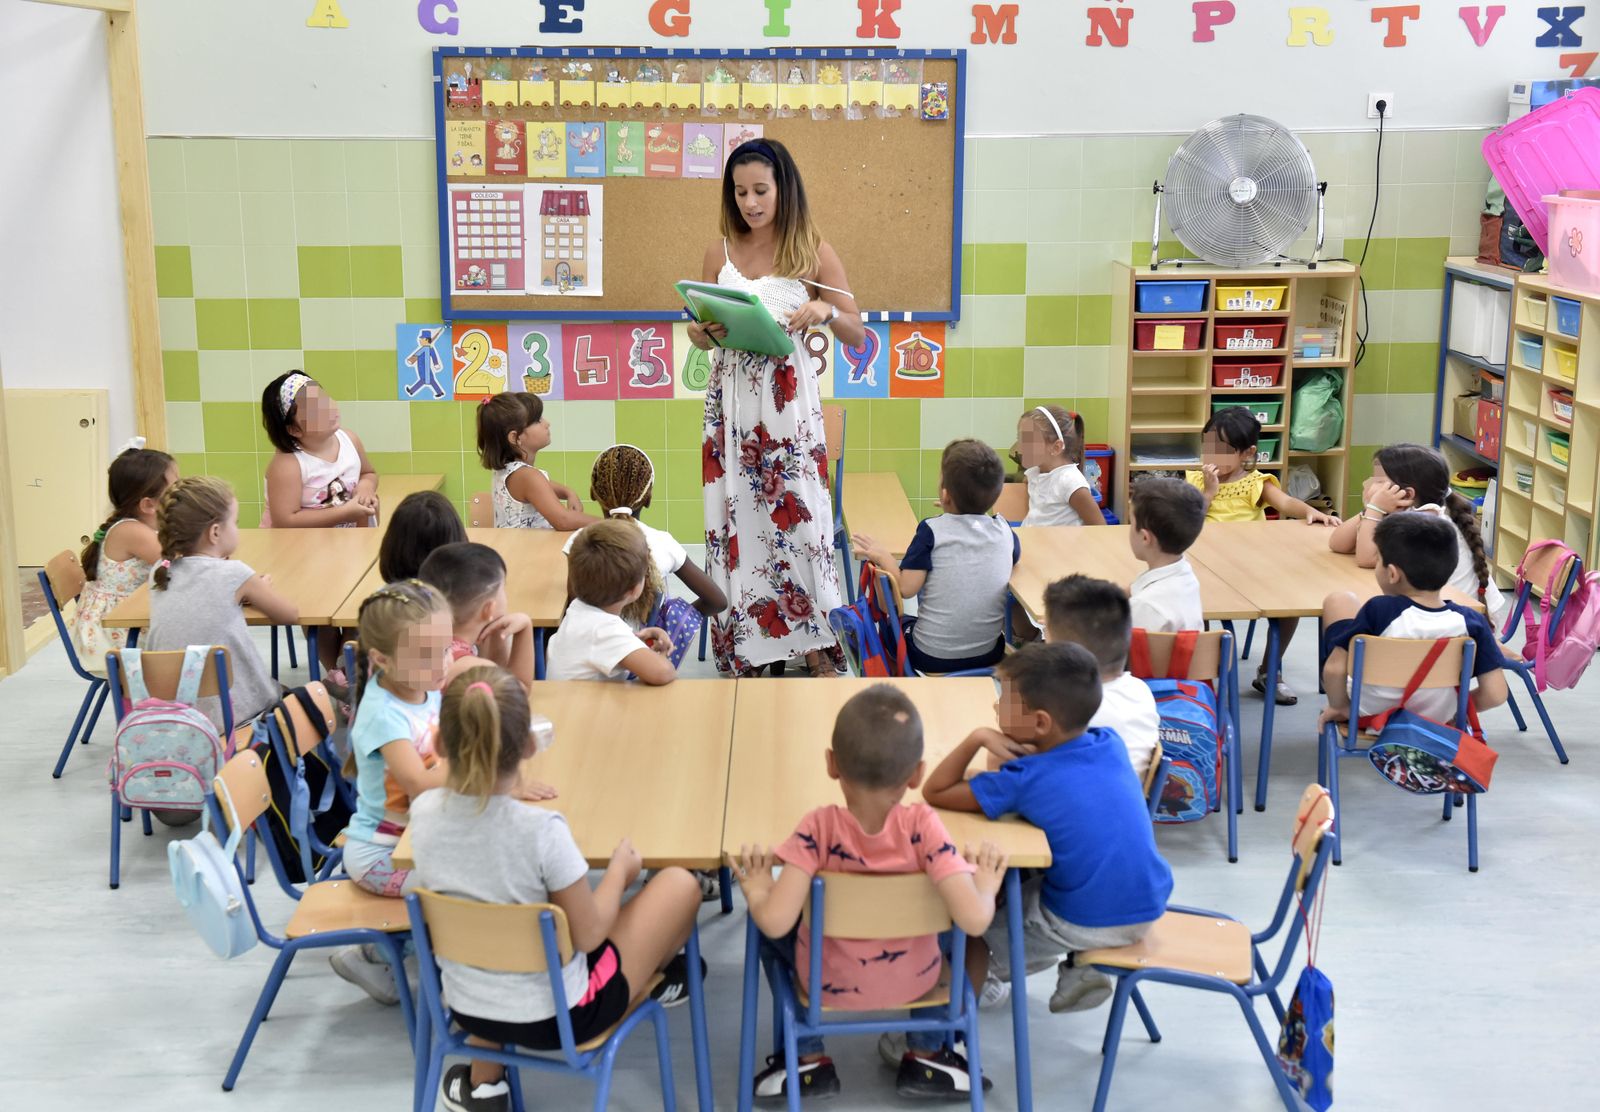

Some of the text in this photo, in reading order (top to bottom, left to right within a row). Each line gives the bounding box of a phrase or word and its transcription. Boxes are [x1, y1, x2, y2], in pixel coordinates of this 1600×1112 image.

[306, 0, 349, 28] A
[418, 0, 459, 35] C
[539, 0, 585, 33] E
[649, 0, 691, 37] G
[763, 0, 791, 37] I
[856, 0, 901, 38] K
[970, 4, 1019, 44] M
[1192, 0, 1236, 43] P
[1286, 6, 1335, 47] R
[1371, 5, 1420, 48] T
[1458, 5, 1506, 47] V
[1535, 6, 1585, 48] X
[455, 332, 489, 394] 2
[523, 332, 550, 378] 3
[576, 336, 607, 383] 4
[637, 339, 663, 385] 5
[806, 332, 829, 375] 8
[848, 335, 874, 381] 9
[903, 349, 934, 371] 10
